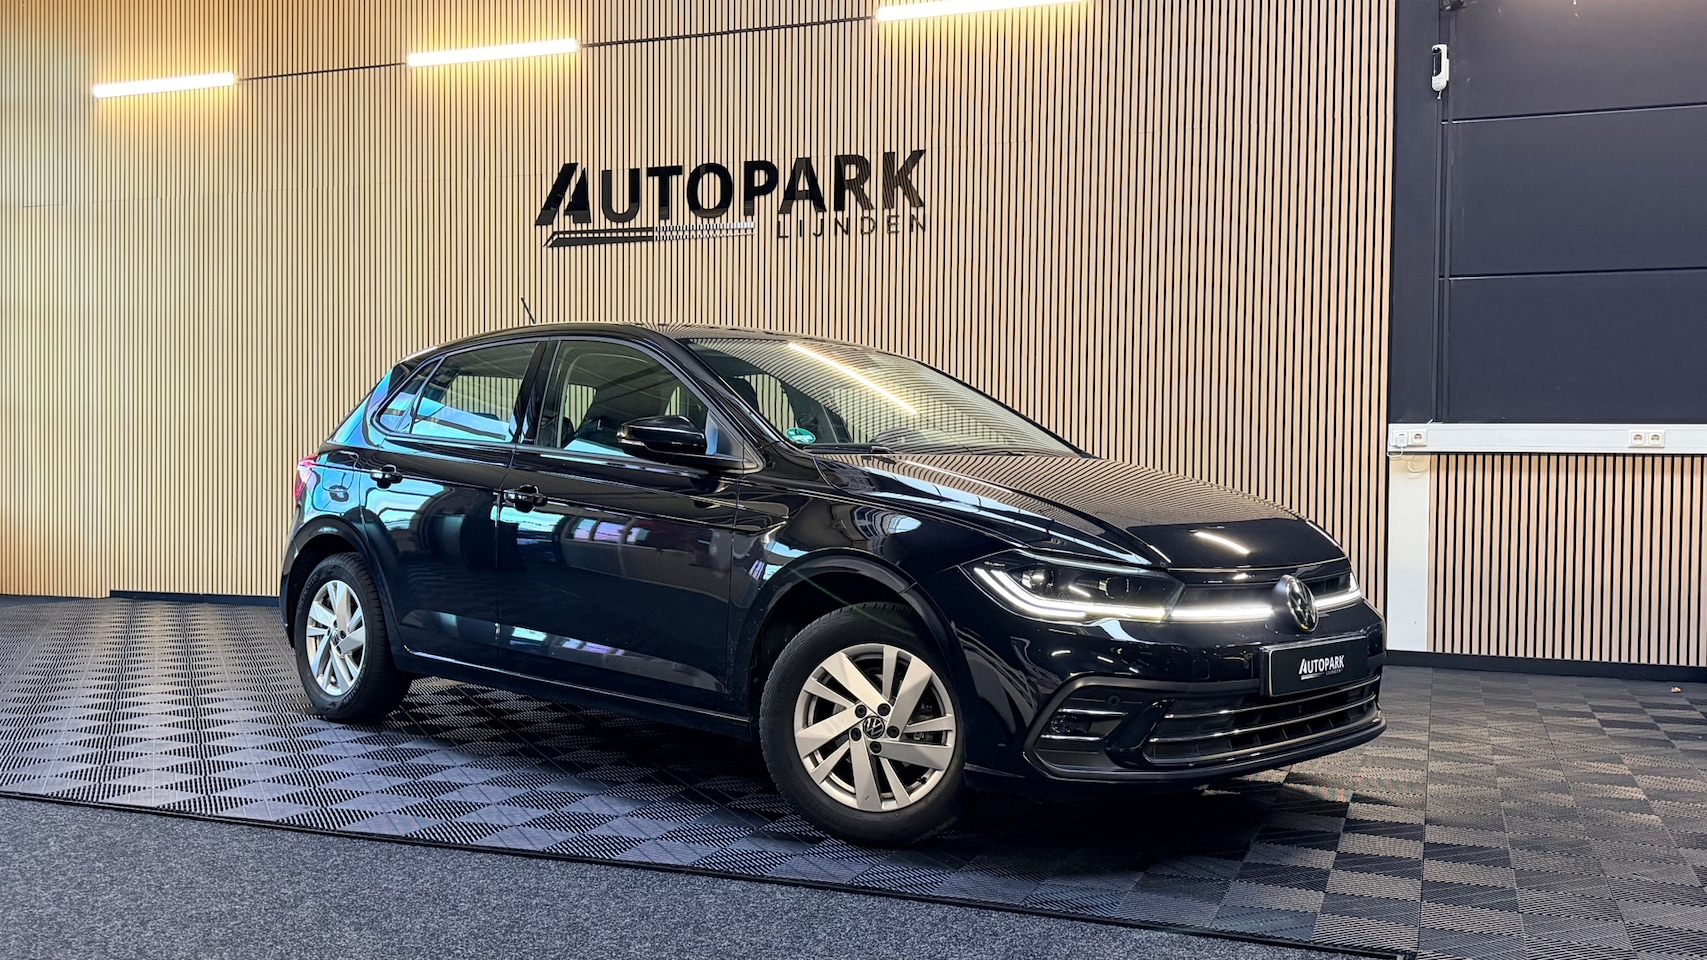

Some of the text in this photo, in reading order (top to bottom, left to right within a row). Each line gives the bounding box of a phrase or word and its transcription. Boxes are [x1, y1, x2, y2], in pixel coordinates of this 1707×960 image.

[534, 149, 927, 226] AUTOPARK
[777, 213, 926, 239] LIJNDEN
[1298, 654, 1345, 675] AUTOPARK
